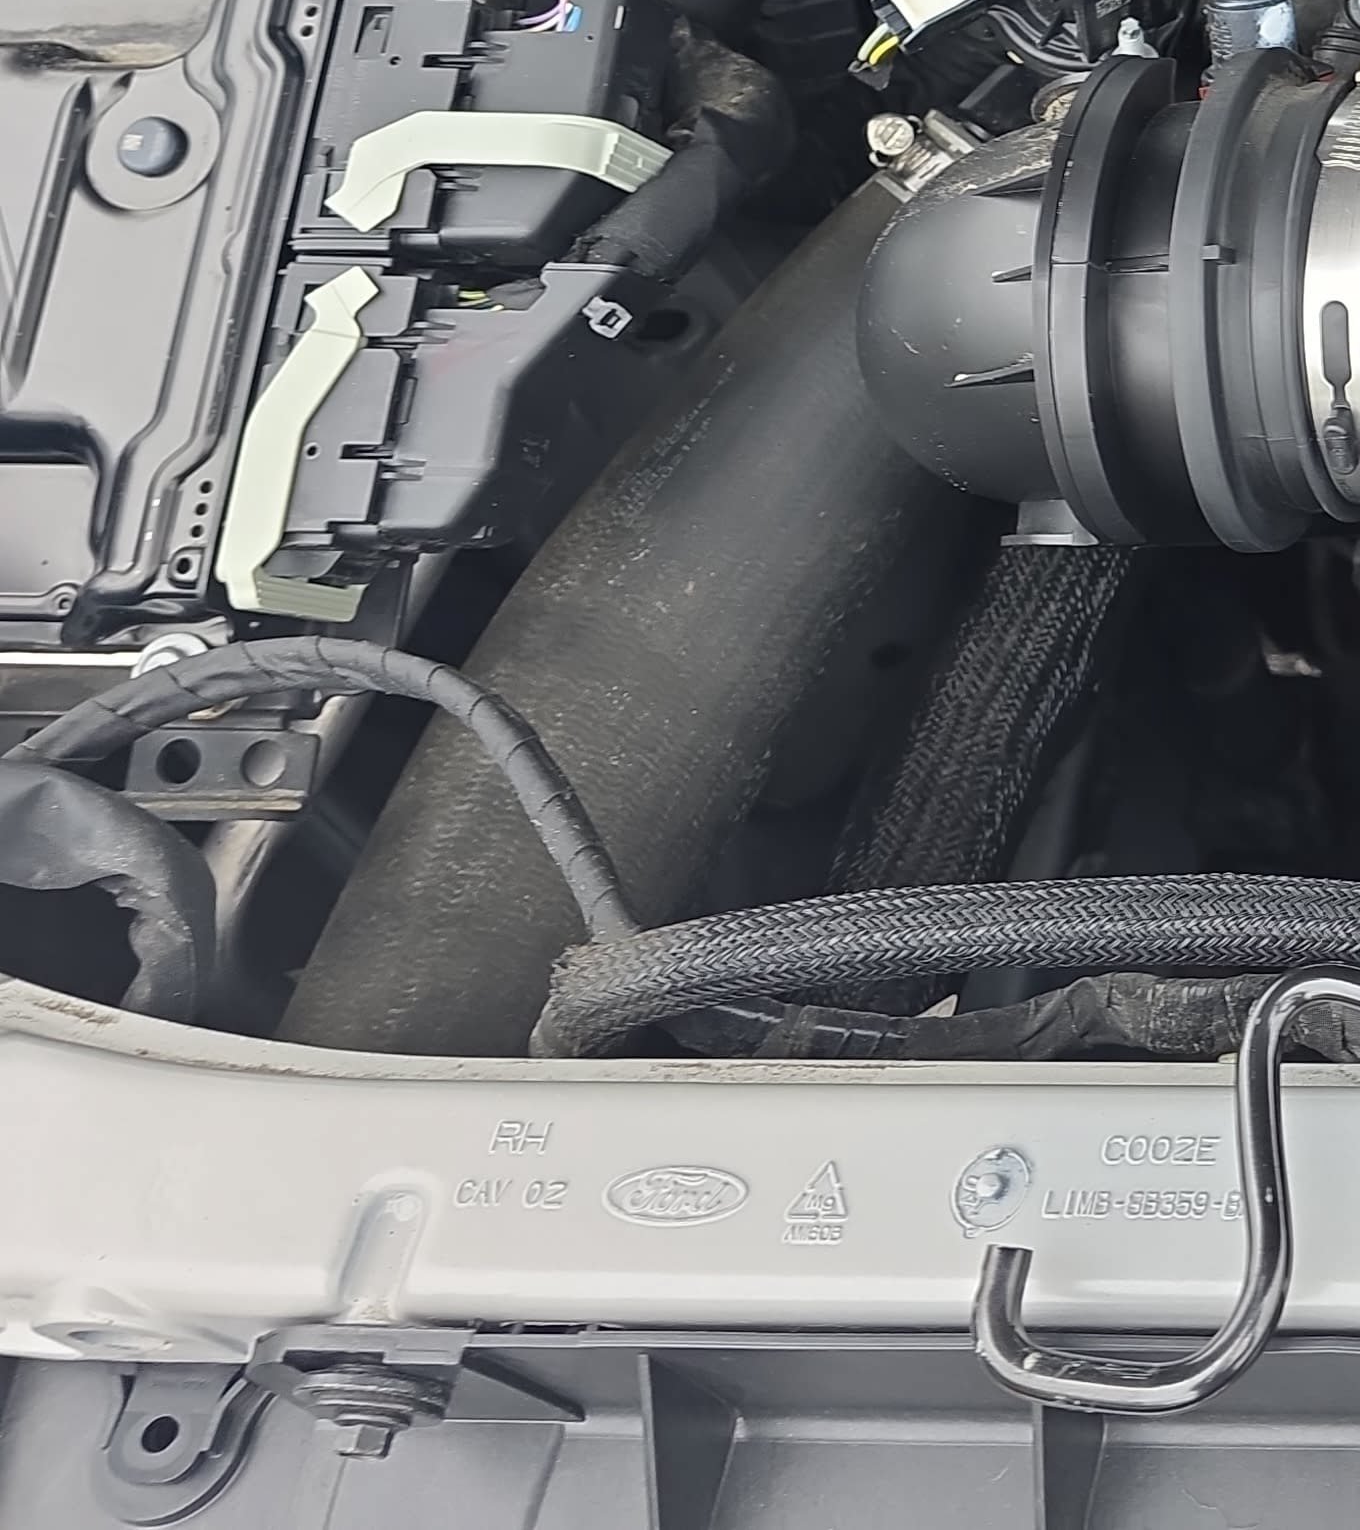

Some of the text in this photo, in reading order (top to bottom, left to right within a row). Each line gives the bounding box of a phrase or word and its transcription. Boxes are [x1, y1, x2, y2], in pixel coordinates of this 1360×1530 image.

[487, 1118, 554, 1155] RH
[453, 1179, 571, 1210] CAV 02
